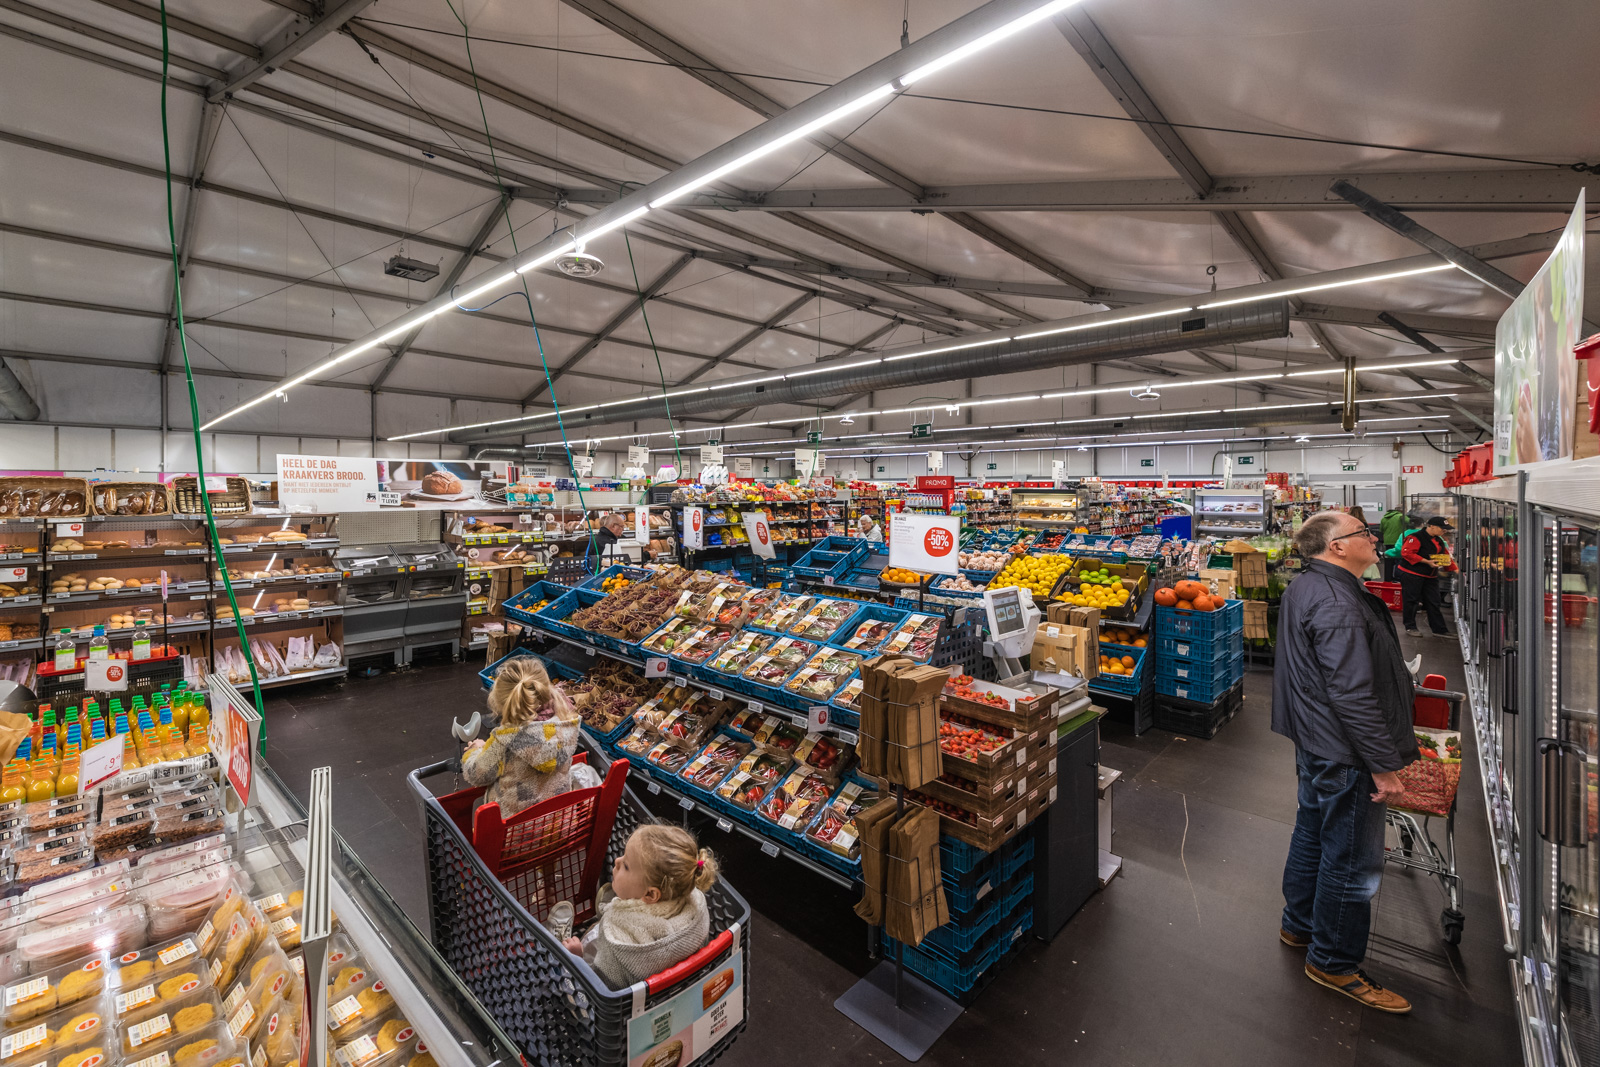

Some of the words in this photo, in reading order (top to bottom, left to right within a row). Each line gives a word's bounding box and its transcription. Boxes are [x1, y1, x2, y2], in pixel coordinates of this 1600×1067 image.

[282, 459, 304, 468] HEEL
[307, 460, 318, 468] DE
[320, 460, 337, 469] DAG
[283, 470, 334, 480] KRAAKVERS
[336, 471, 366, 480] BROOD.
[928, 535, 949, 547] -50%
[109, 758, 115, 768] 9
